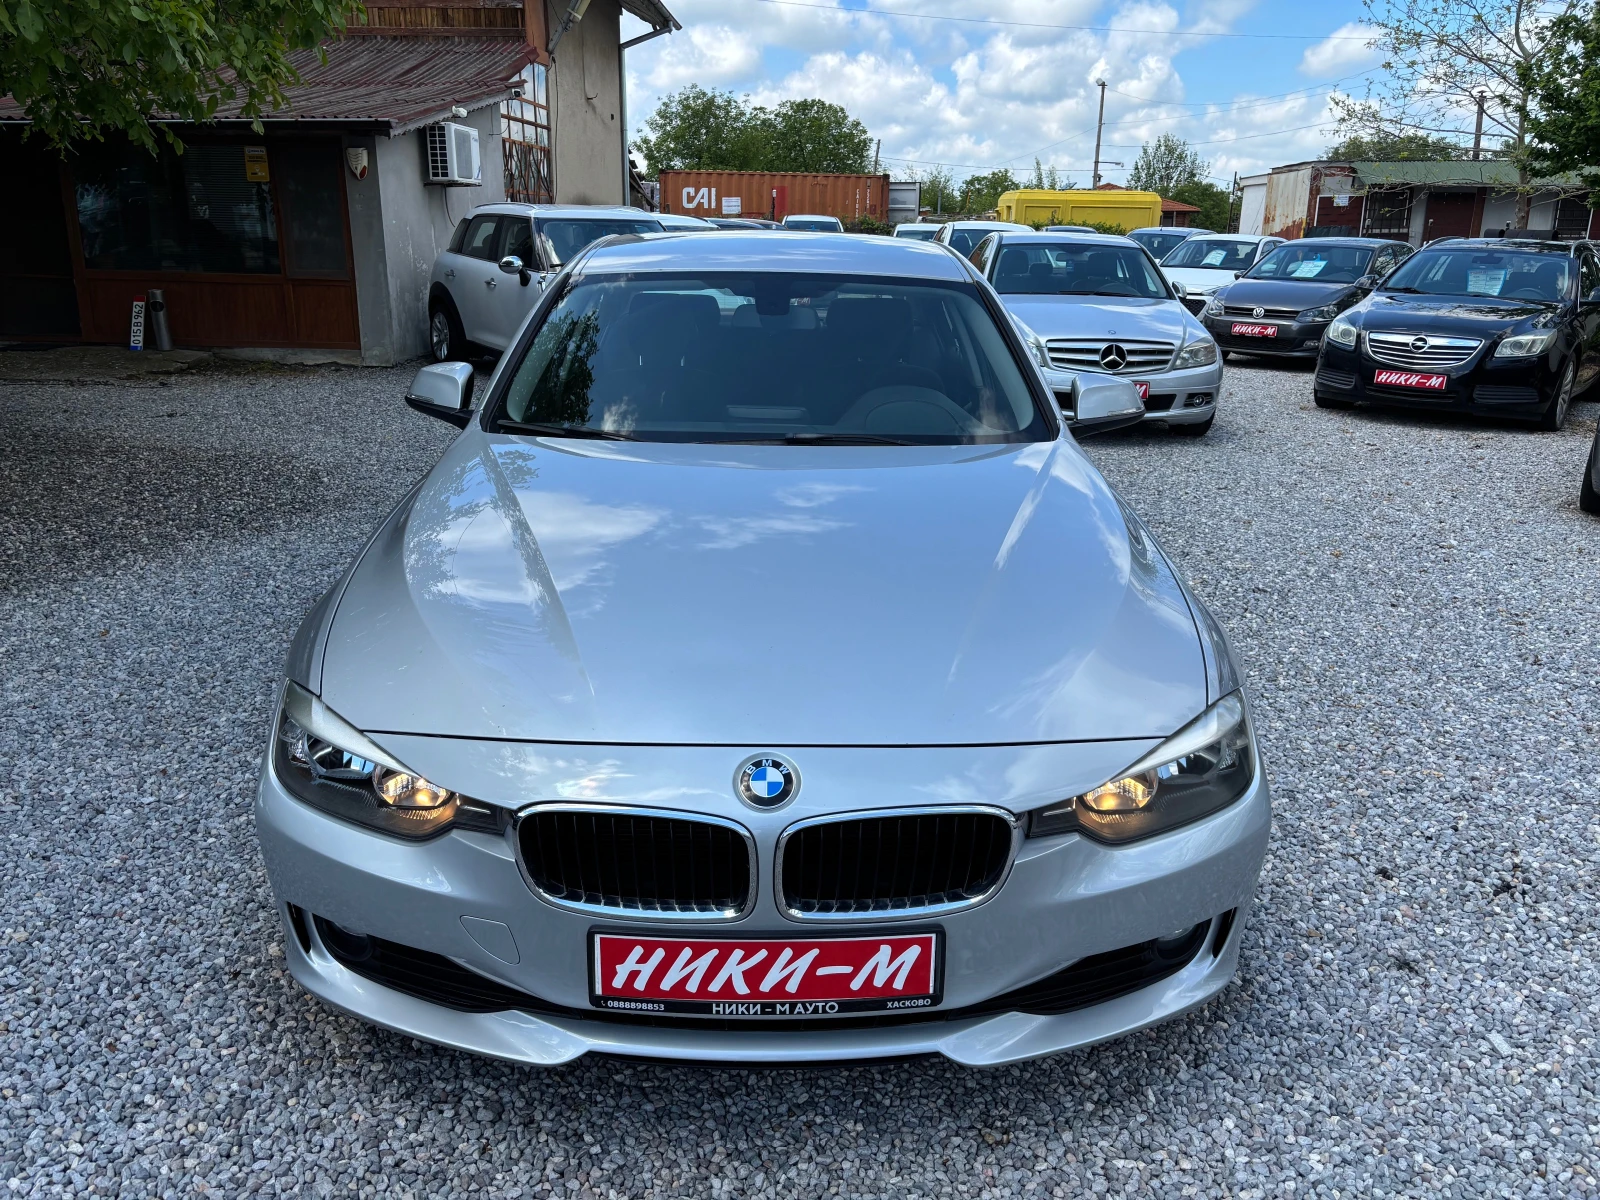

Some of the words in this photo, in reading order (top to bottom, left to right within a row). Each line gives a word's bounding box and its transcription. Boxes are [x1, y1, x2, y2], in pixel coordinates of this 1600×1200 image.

[682, 187, 716, 209] CAI
[745, 759, 790, 775] BMW
[607, 1000, 665, 1011] 0888898853
[793, 1001, 839, 1015] АУТО
[886, 998, 931, 1009] ХАСКОВО
